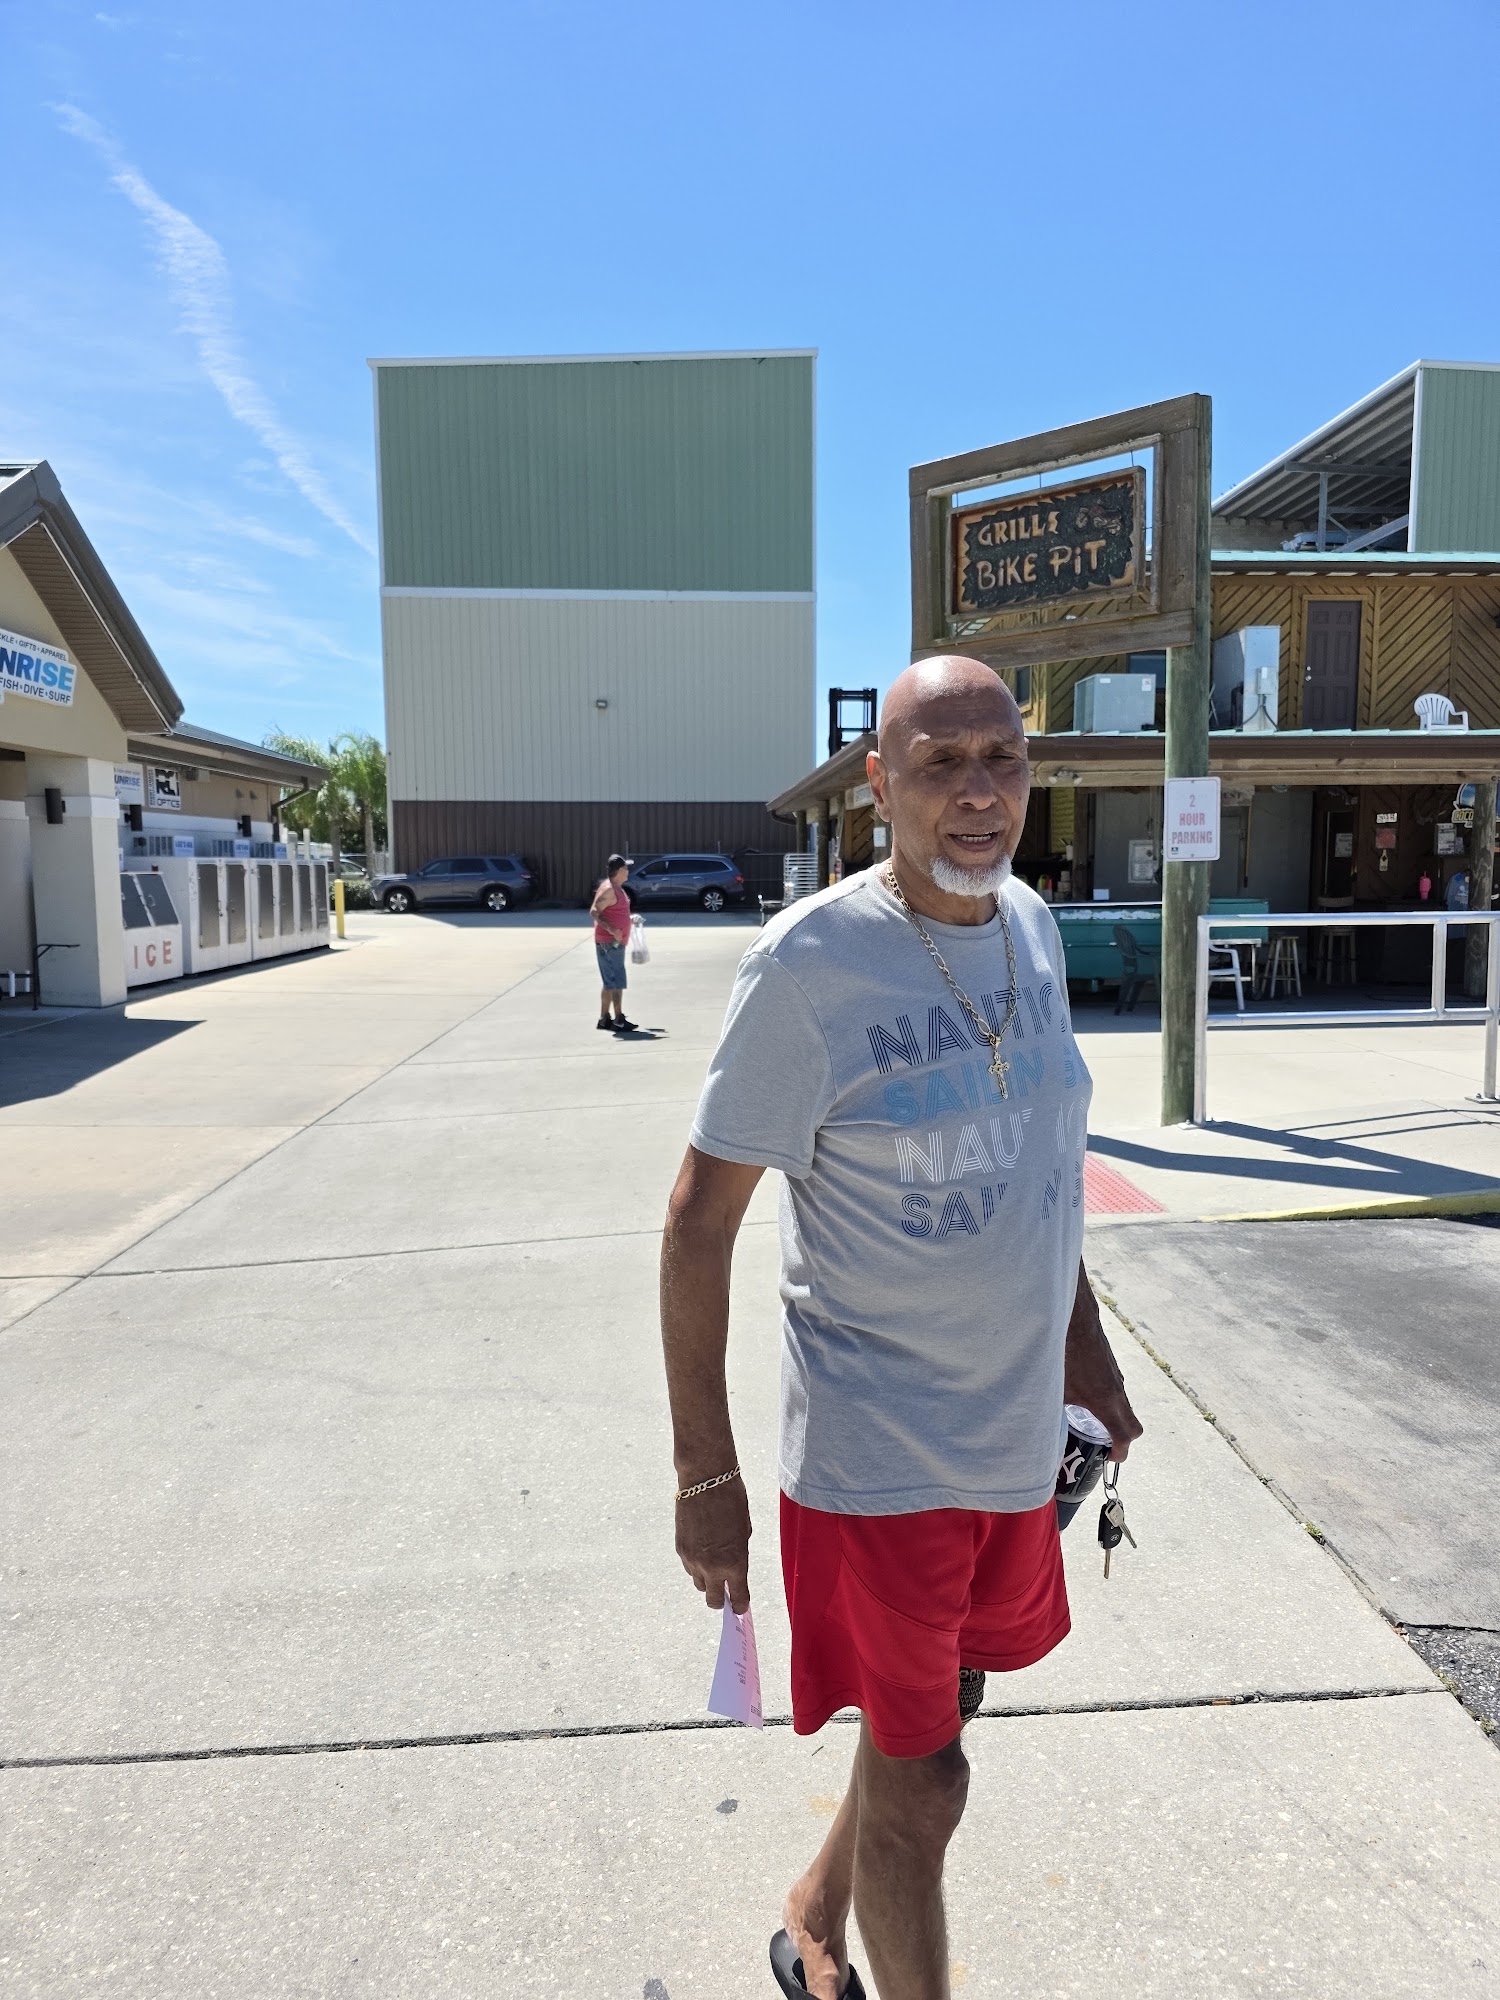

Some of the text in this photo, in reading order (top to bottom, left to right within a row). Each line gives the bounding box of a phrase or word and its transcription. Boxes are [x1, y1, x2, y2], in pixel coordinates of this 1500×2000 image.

[978, 511, 1061, 546] GRILLS
[19, 640, 37, 652] GIFTS
[40, 647, 67, 662] APPAREL
[23, 683, 45, 698] DIVE
[48, 690, 71, 704] SURF
[1189, 794, 1196, 808] 2
[1179, 812, 1206, 826] HOUR
[1171, 831, 1213, 844] PARKING
[133, 940, 172, 969] ICE
